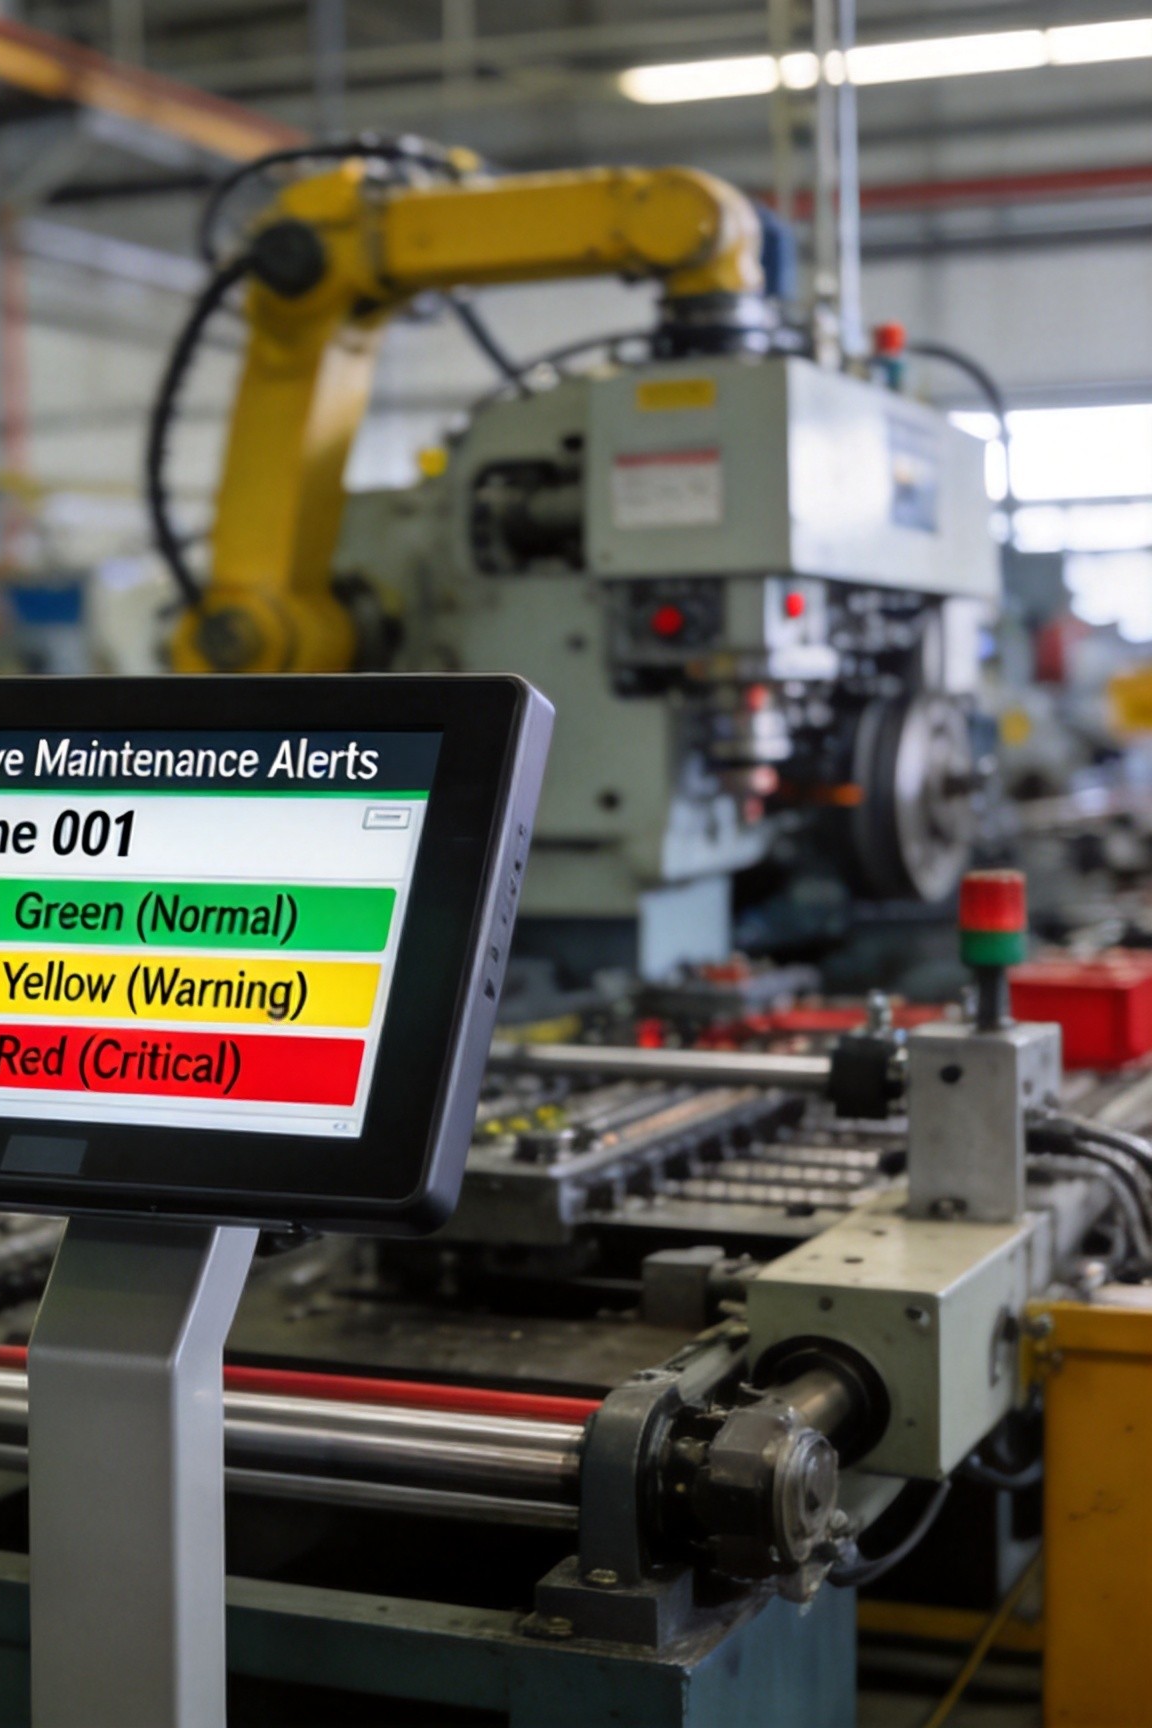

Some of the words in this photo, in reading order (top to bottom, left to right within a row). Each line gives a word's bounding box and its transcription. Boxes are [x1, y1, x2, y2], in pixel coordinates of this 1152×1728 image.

[35, 738, 259, 778] Maintenance
[268, 739, 380, 781] Alerts
[52, 808, 135, 858] 001
[15, 892, 124, 933] Green
[136, 890, 298, 945] (Normal)
[2, 962, 115, 1004] Yellow
[126, 963, 309, 1021] (Warning)
[78, 1037, 243, 1093] (Critical)
